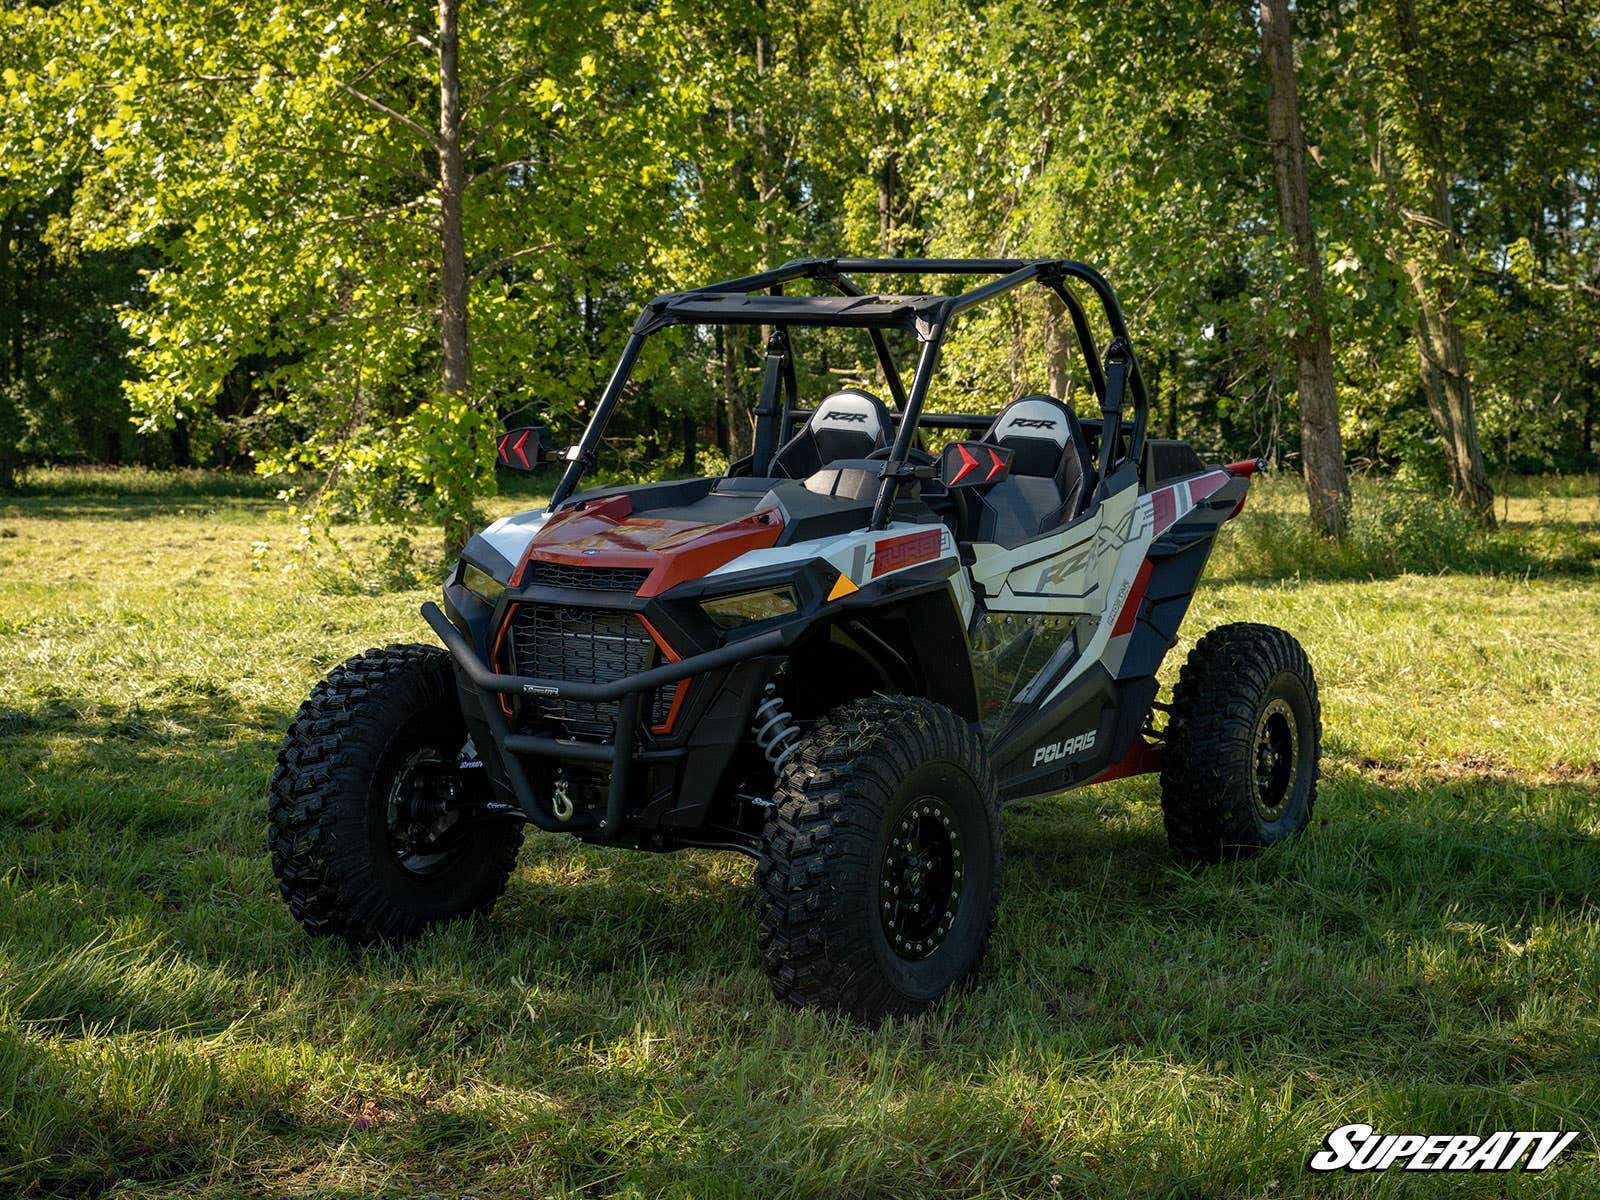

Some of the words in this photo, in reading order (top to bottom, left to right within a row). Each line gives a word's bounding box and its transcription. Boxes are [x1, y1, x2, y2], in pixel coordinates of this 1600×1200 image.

[822, 411, 868, 424] RZR
[1007, 417, 1058, 430] RZR
[1032, 729, 1098, 767] POLARIS
